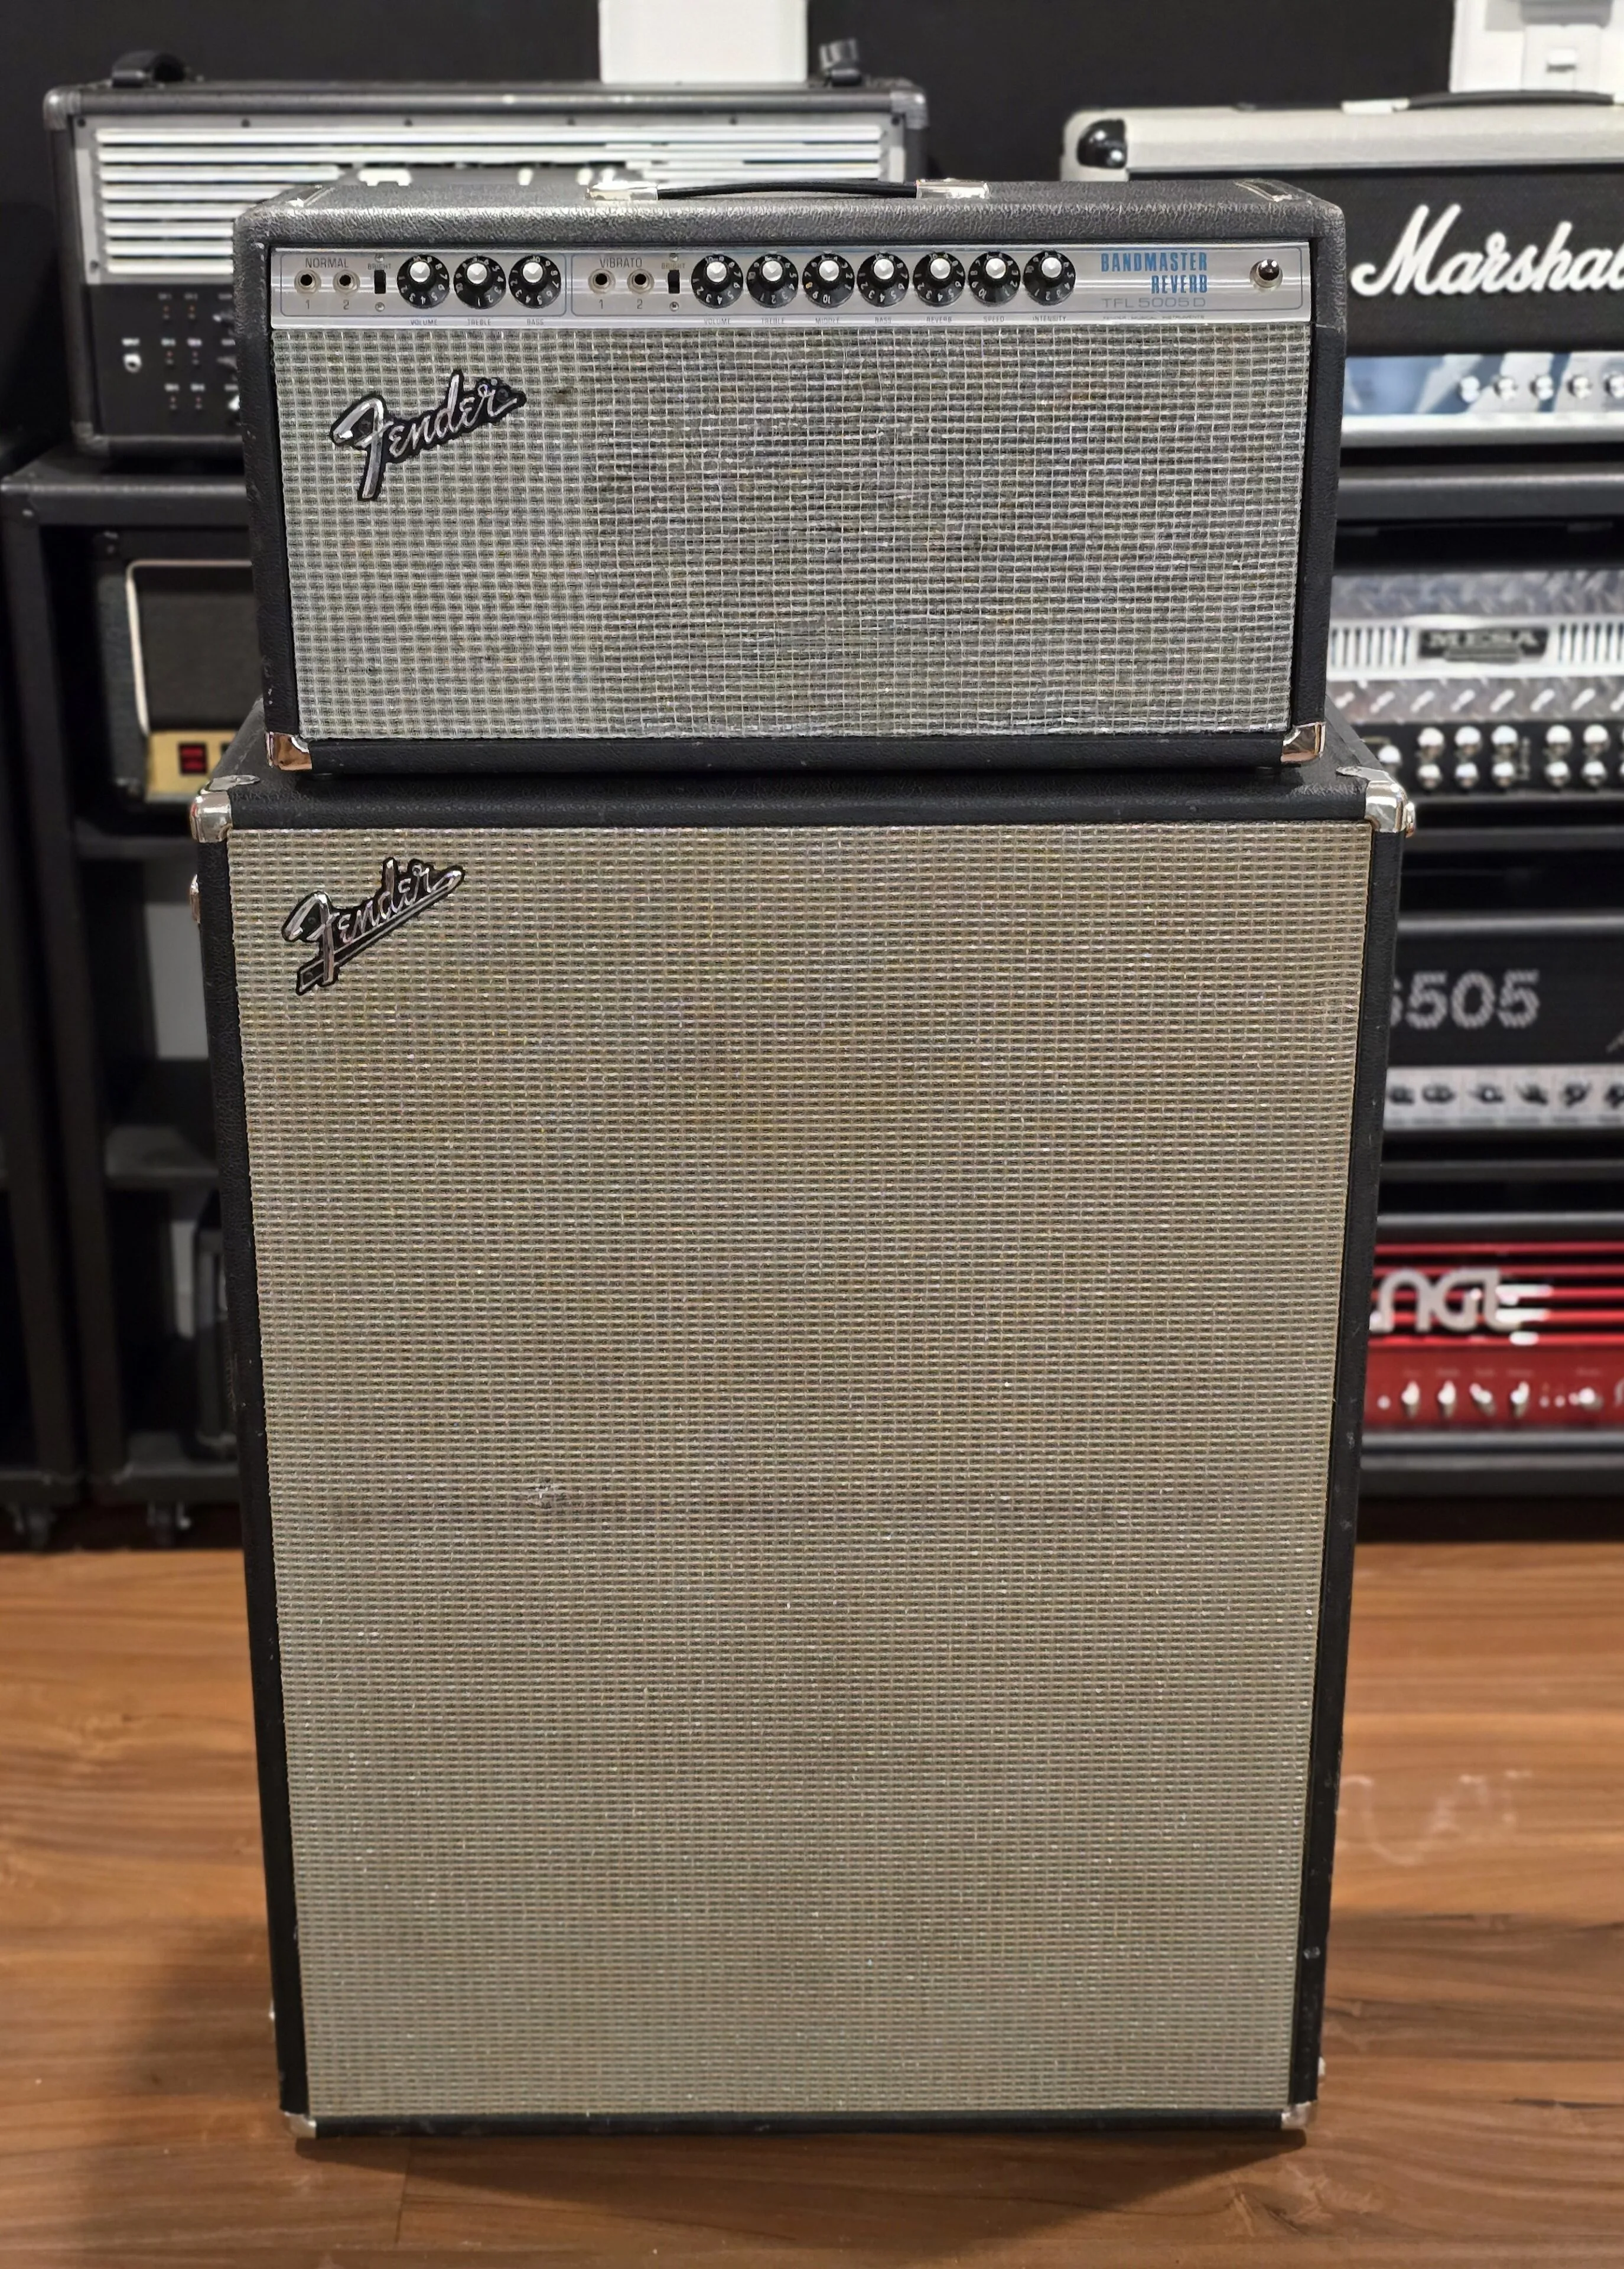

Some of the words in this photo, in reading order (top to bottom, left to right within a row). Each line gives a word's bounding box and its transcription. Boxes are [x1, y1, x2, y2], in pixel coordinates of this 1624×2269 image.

[305, 257, 349, 268] NORMAL
[599, 257, 643, 268] VIBRATO
[1101, 252, 1208, 272] BANDMASTER
[1151, 274, 1208, 294] REVERB
[305, 299, 310, 310] 1
[343, 299, 350, 310] 2
[598, 298, 604, 309] 1
[636, 298, 643, 310] 2
[1101, 297, 1134, 308] TFL
[1138, 297, 1190, 308] 5005
[330, 370, 526, 501] Fender
[1428, 629, 1540, 648] MESA
[282, 857, 466, 995] Fender
